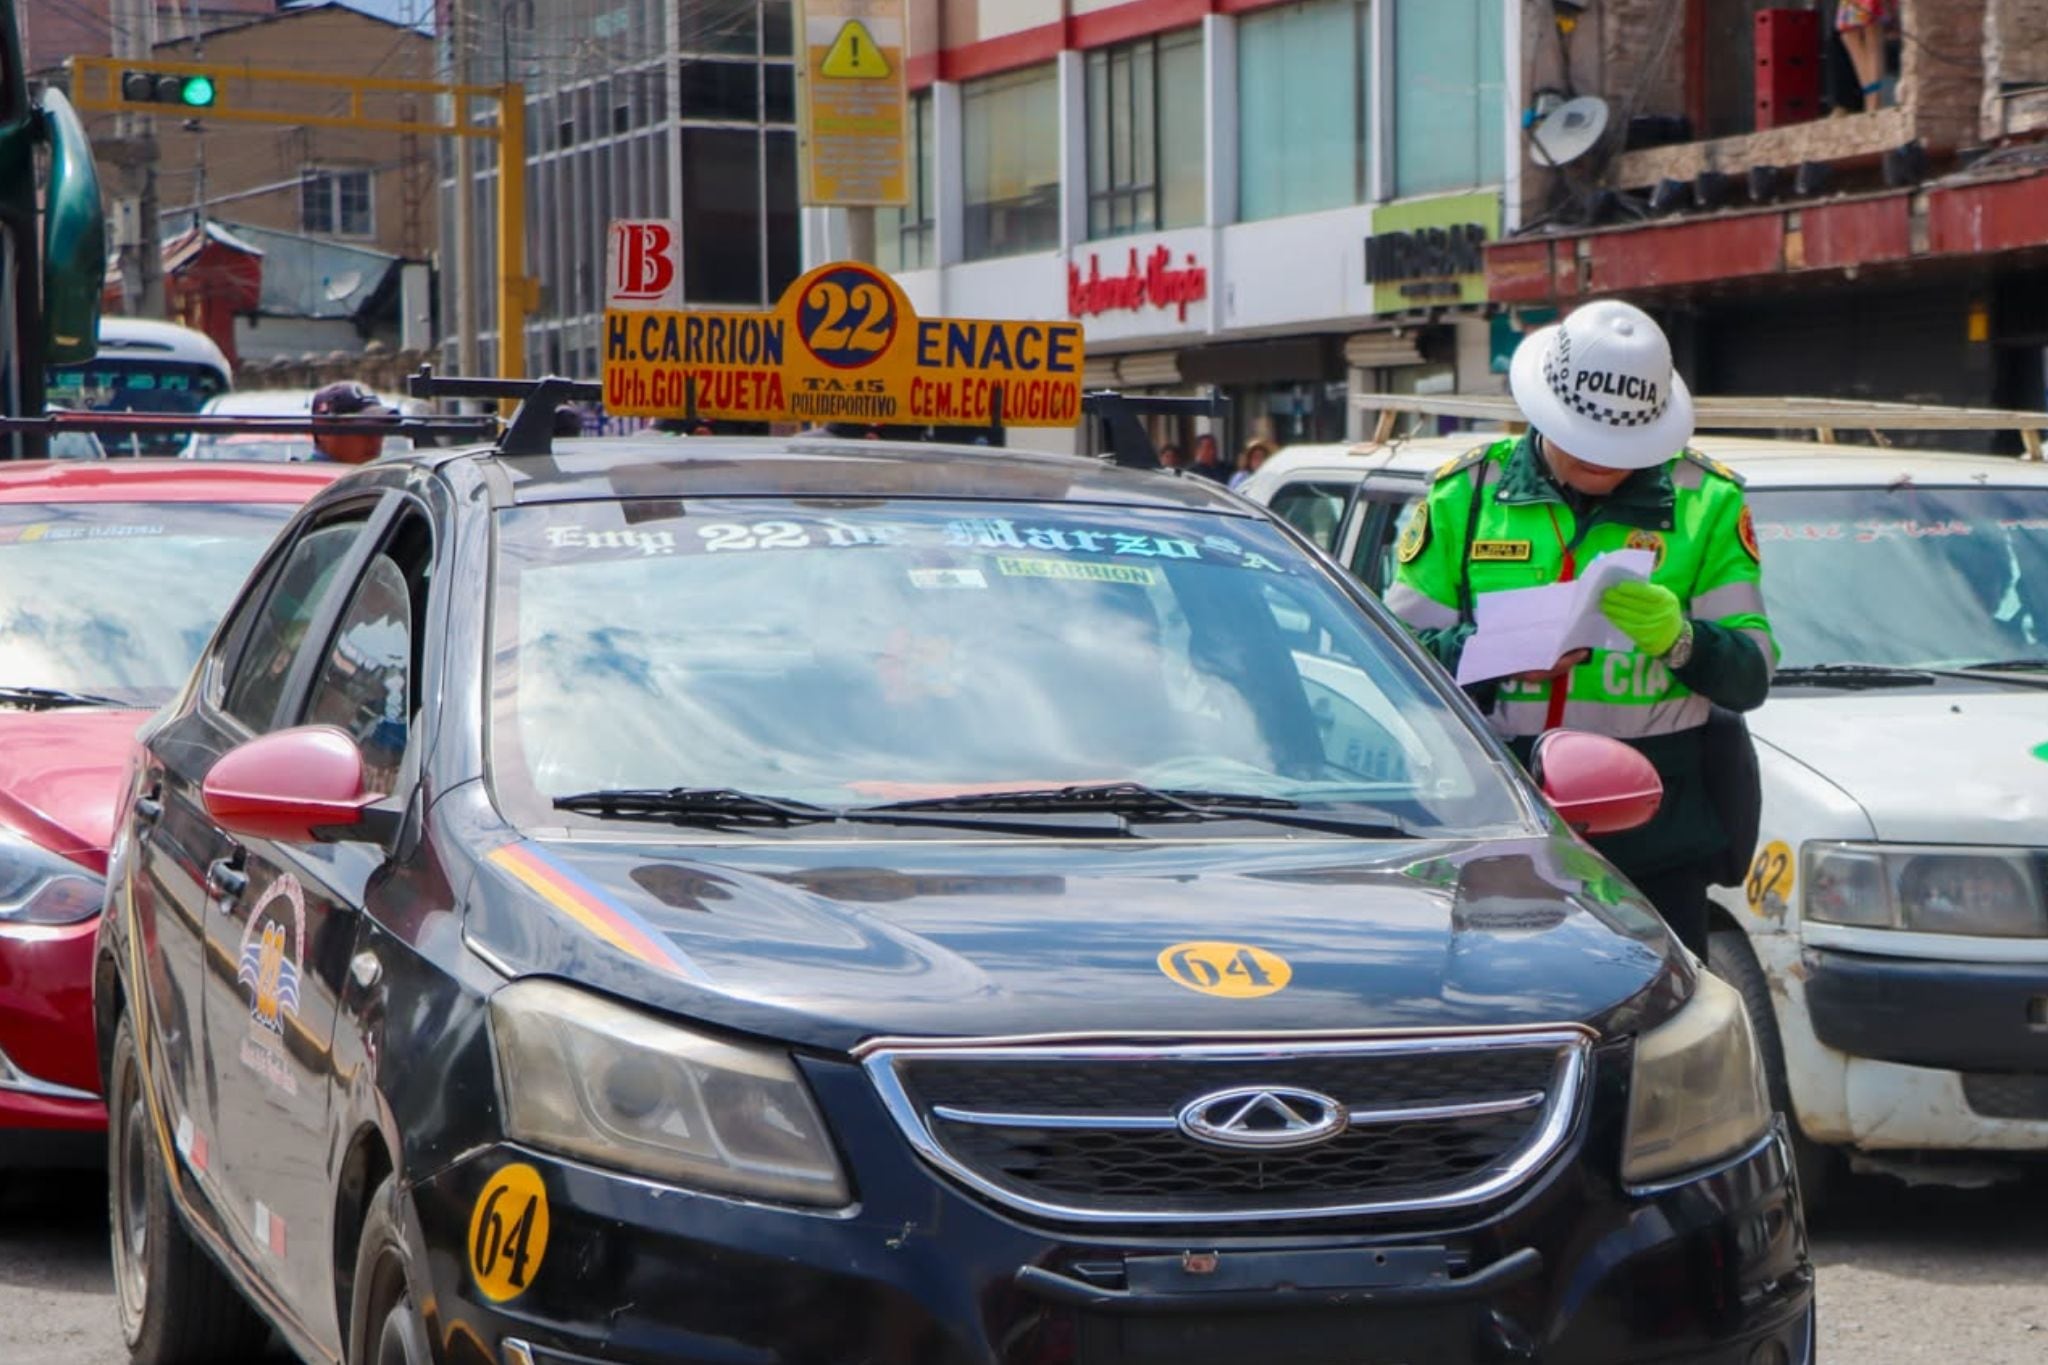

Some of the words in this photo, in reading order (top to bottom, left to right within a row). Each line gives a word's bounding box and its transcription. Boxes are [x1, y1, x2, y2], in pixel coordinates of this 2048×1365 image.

[611, 223, 675, 300] B
[807, 282, 891, 351] 22
[917, 321, 1077, 373] ENACE
[791, 392, 897, 417] POLIDEPORTIVO
[1575, 370, 1658, 405] POLICIA
[699, 520, 809, 551] 22
[1747, 850, 1788, 906] 82
[1170, 949, 1276, 988] 64
[475, 1185, 539, 1289] 64
